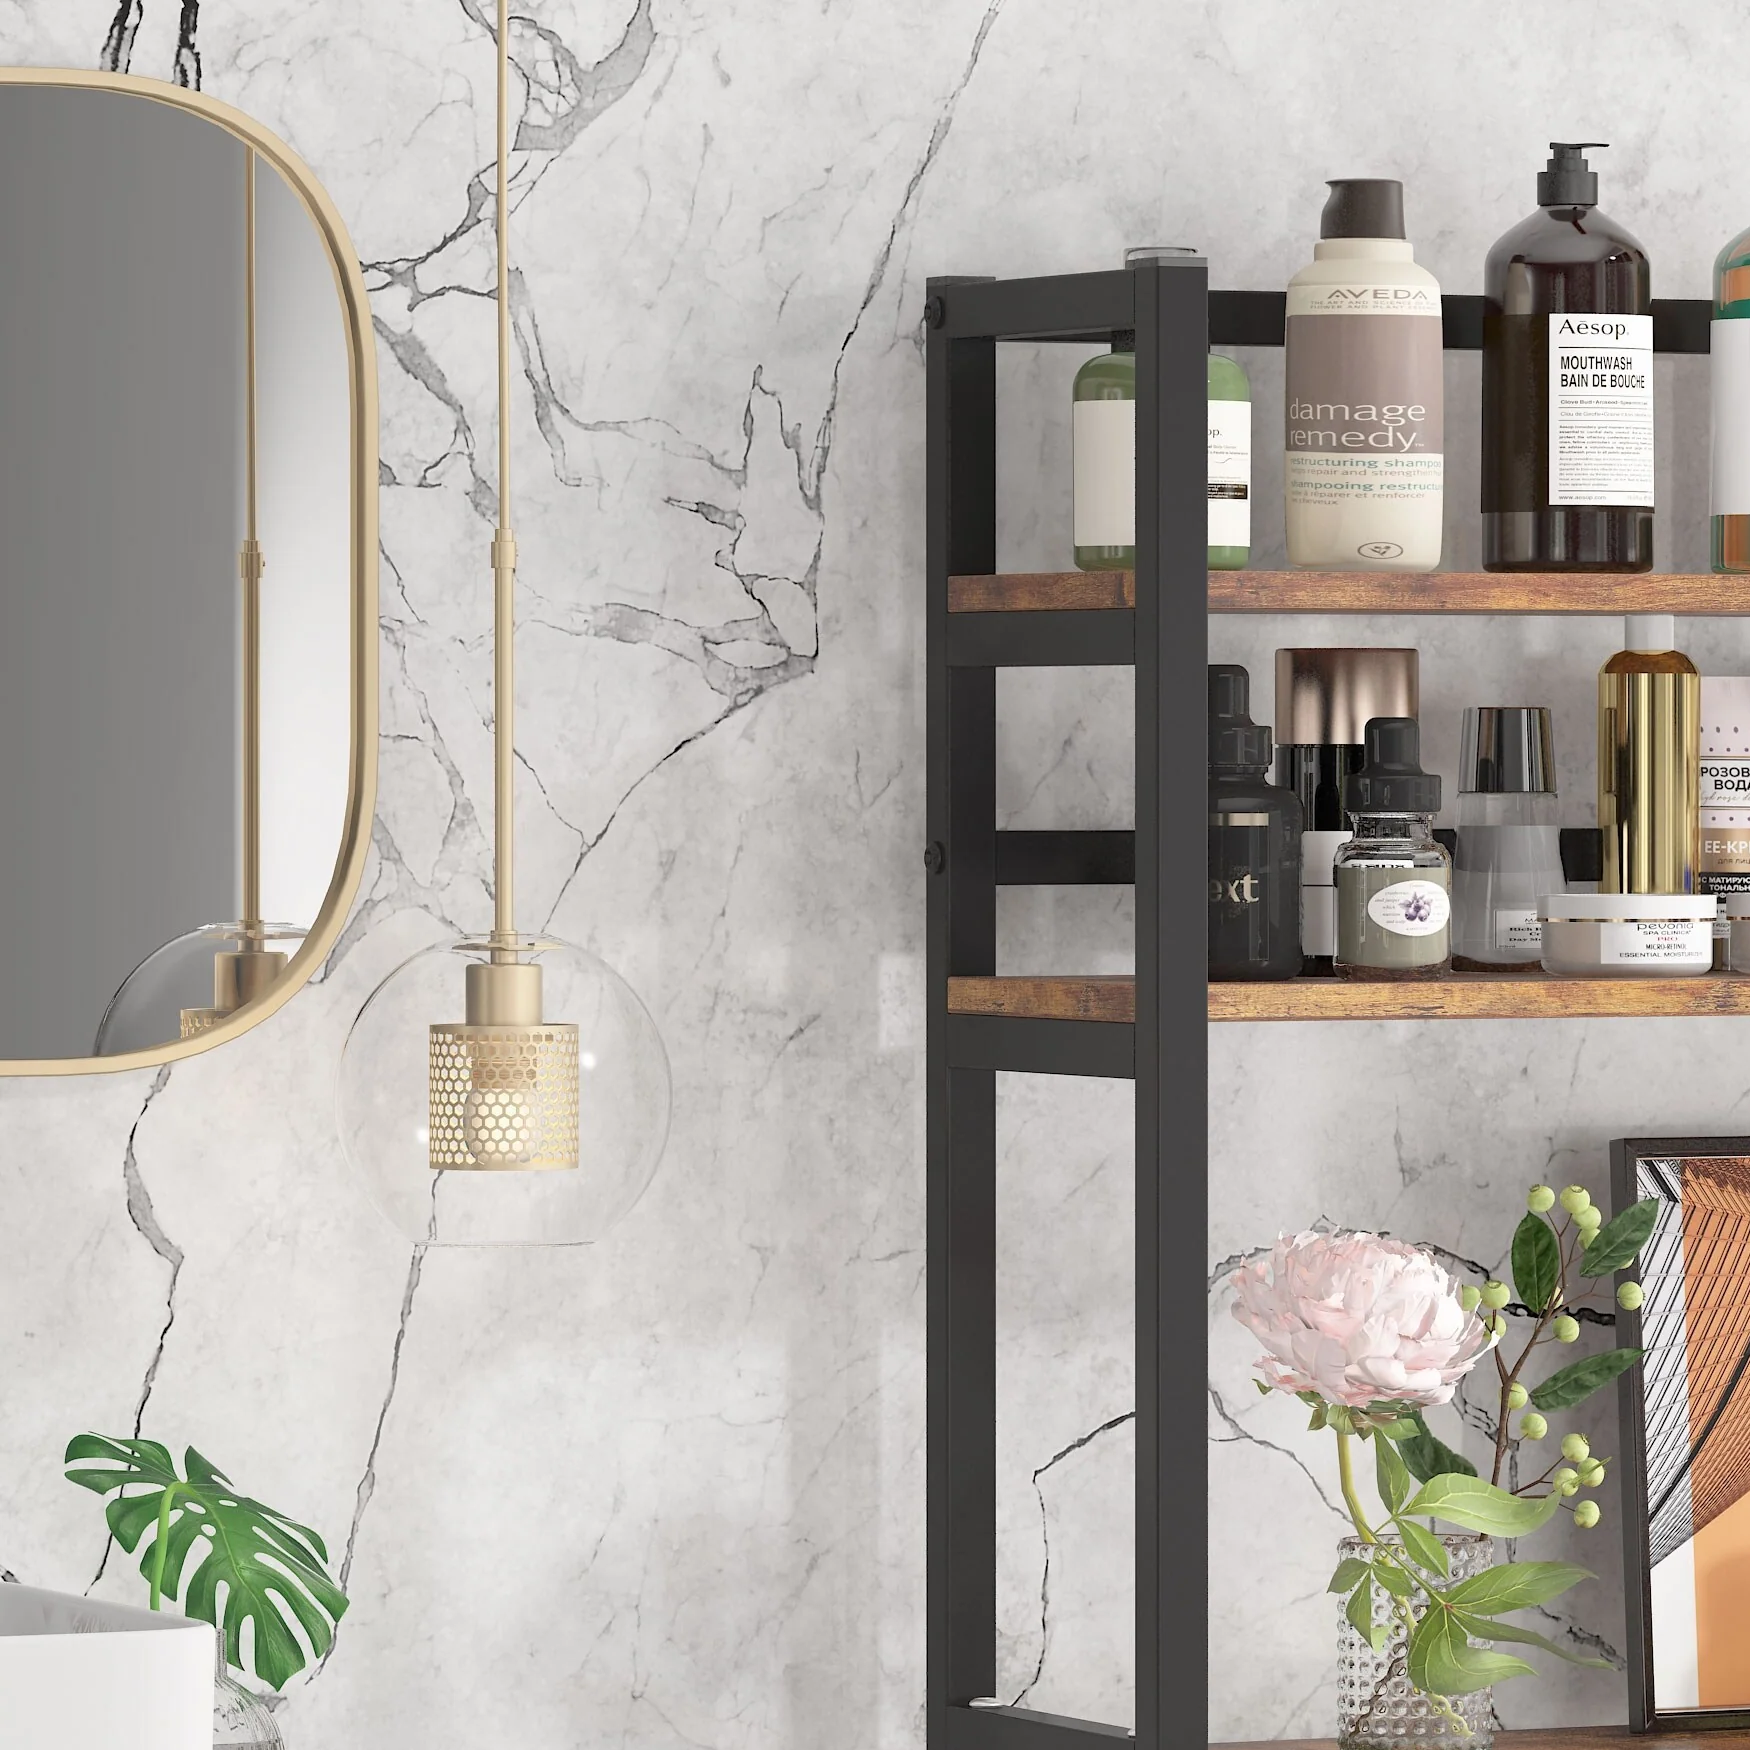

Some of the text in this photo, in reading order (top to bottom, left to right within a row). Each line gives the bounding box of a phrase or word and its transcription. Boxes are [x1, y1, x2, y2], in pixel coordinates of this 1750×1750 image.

[1328, 289, 1427, 300] AVEDA
[1561, 356, 1632, 370] MOUTHWASH
[1561, 374, 1645, 388] BAIN DE BOUCHE
[1290, 398, 1425, 426] damage
[1637, 923, 1694, 931] pevonia
